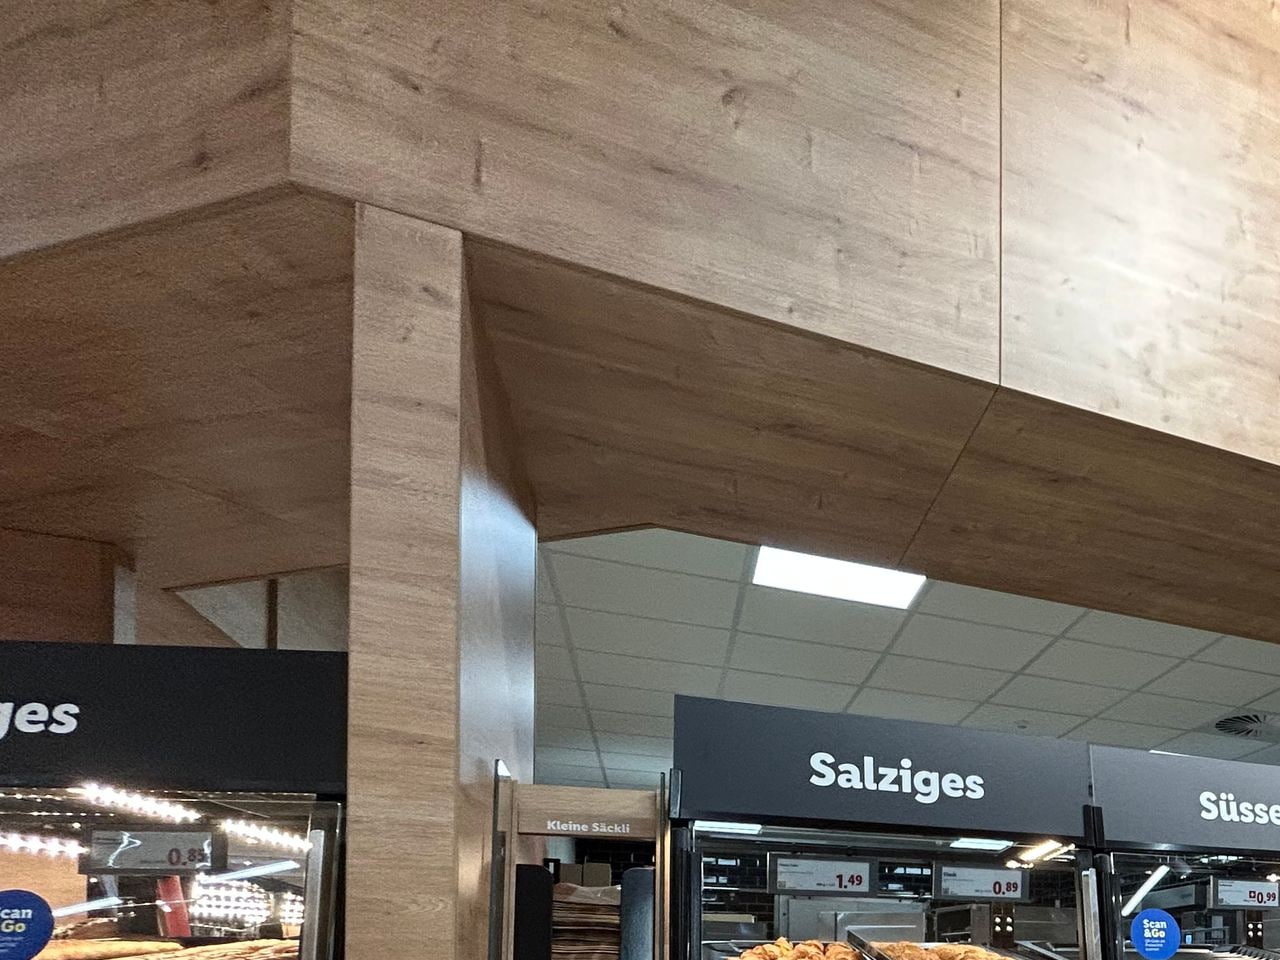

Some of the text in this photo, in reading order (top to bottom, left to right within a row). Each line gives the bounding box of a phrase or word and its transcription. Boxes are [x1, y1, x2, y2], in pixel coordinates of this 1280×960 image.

[808, 751, 985, 804] Salziges
[546, 819, 631, 834] Kleine Säckli
[835, 873, 863, 889] 1.49
[992, 881, 1019, 895] 0.89
[1256, 891, 1277, 905] 0.99
[0, 907, 33, 919] can
[1143, 918, 1168, 929] Scan
[1143, 928, 1166, 938] &Go
